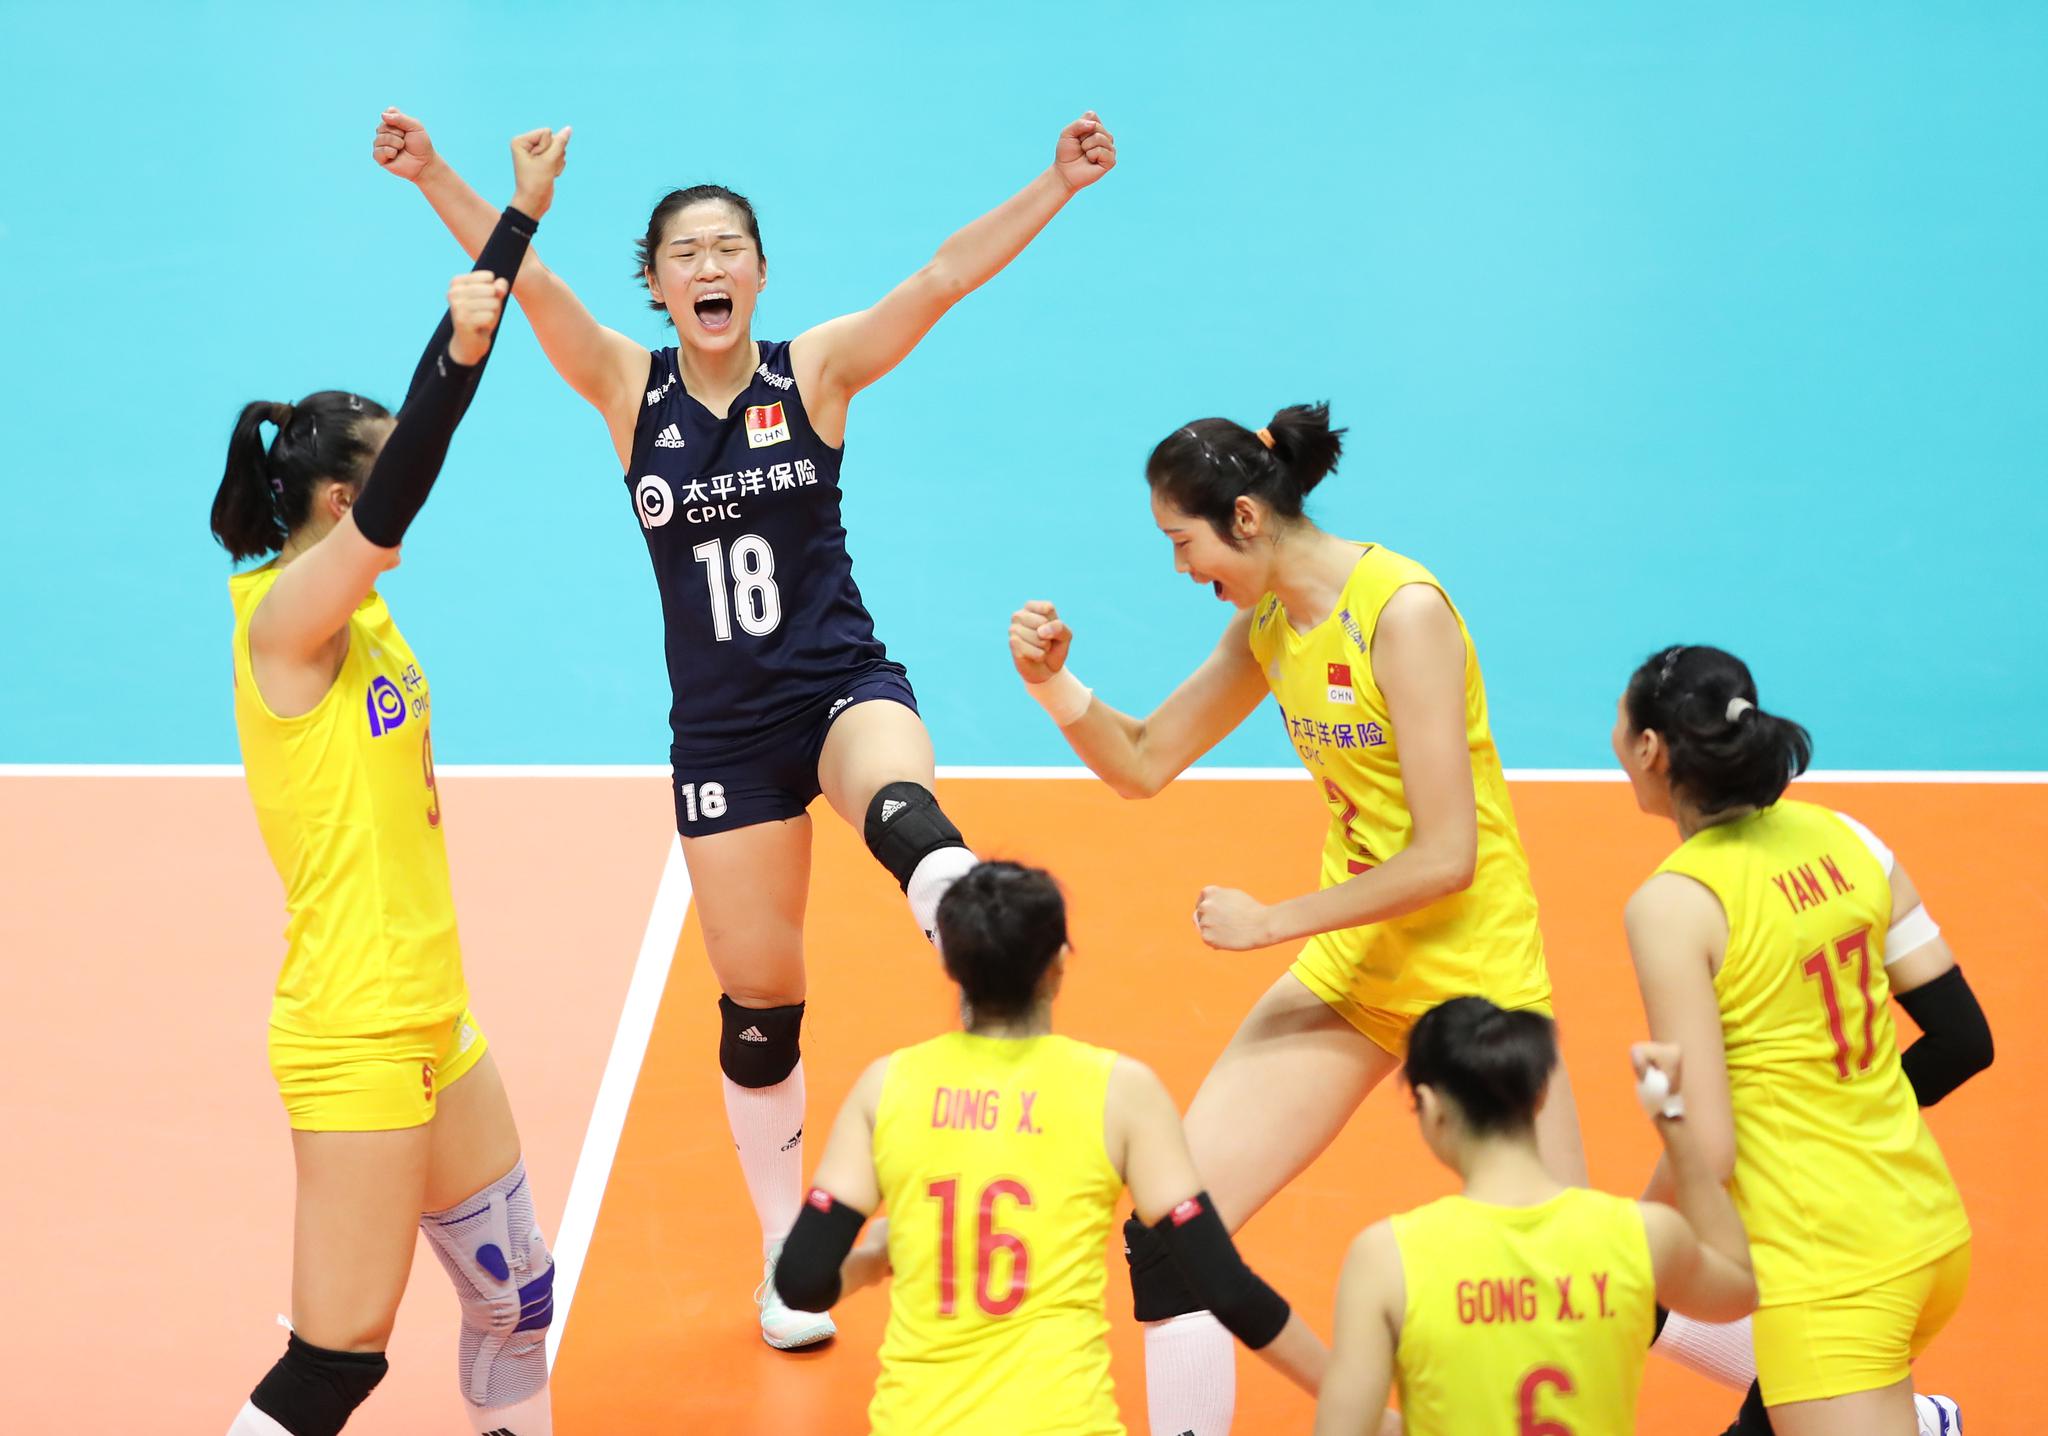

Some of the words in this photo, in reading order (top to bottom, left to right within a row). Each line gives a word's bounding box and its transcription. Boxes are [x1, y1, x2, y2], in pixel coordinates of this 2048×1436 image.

[655, 438, 685, 448] adidas
[754, 429, 784, 443] CHN
[682, 459, 818, 504] 太平洋保险
[686, 502, 741, 524] CPIC
[692, 534, 781, 641] 18
[1330, 689, 1353, 701] CHN
[1291, 715, 1387, 749] 太平洋保险
[681, 782, 728, 822] 18
[1771, 863, 1828, 914] YAN
[1819, 854, 1855, 895] N.
[1801, 924, 1875, 1080] 17
[931, 1087, 998, 1131] DING
[1016, 1091, 1043, 1134] X.
[925, 1175, 1035, 1319] 16
[1457, 1278, 1536, 1325] GONG
[1556, 1275, 1583, 1321] X.
[1592, 1272, 1615, 1318] Y.
